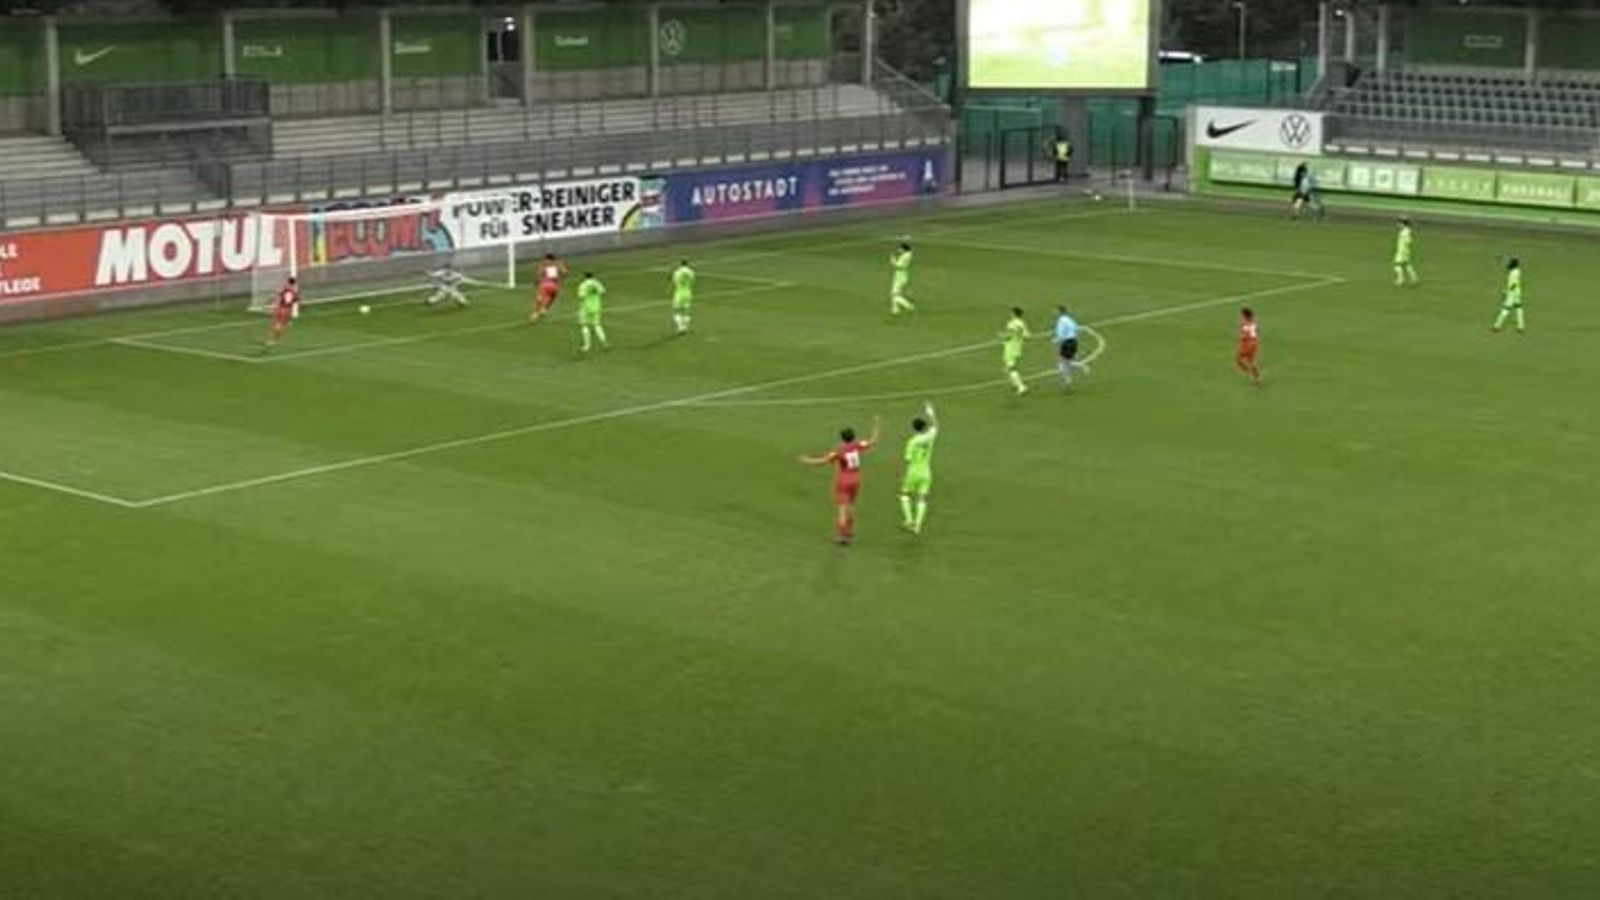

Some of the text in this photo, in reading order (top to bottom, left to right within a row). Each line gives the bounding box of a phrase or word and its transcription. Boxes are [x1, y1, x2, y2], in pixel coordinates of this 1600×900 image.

[691, 176, 797, 205] AUTOSTADT
[522, 206, 615, 236] SNEAKER
[96, 214, 281, 285] MOTUL
